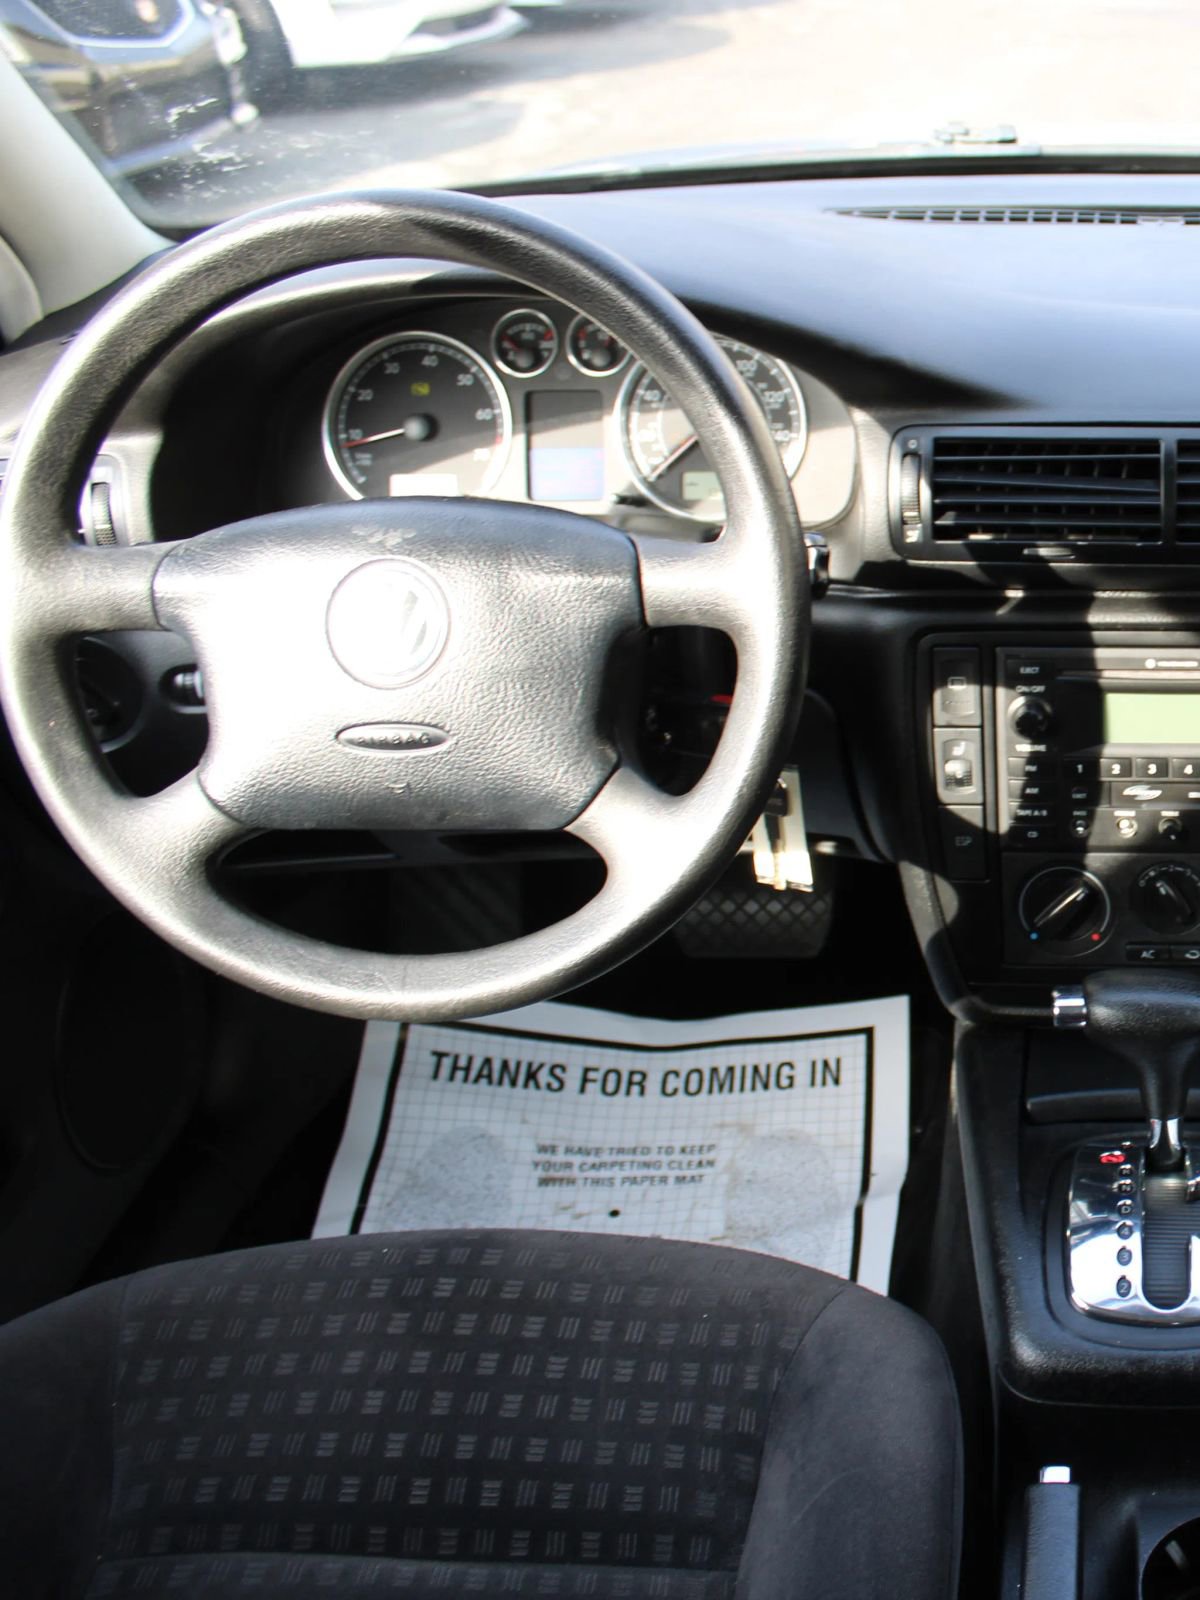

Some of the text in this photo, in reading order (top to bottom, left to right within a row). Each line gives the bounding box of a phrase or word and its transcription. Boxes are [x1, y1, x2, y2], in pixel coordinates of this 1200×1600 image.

[422, 355, 438, 366] 40
[456, 373, 474, 386] 50
[475, 408, 493, 421] 60
[1076, 763, 1084, 775] 1
[1111, 763, 1121, 775] 2
[1147, 763, 1157, 775] 3
[1183, 763, 1194, 775] 4
[1140, 950, 1155, 959] AC
[431, 1051, 842, 1098] THANKS FOR COMING IN
[536, 1143, 717, 1158] WE HAVE TRIED TO KEEP
[532, 1158, 716, 1173] YOUR CARPETING CLEAN
[537, 1174, 705, 1188] WITH THIS PAPER MAT
